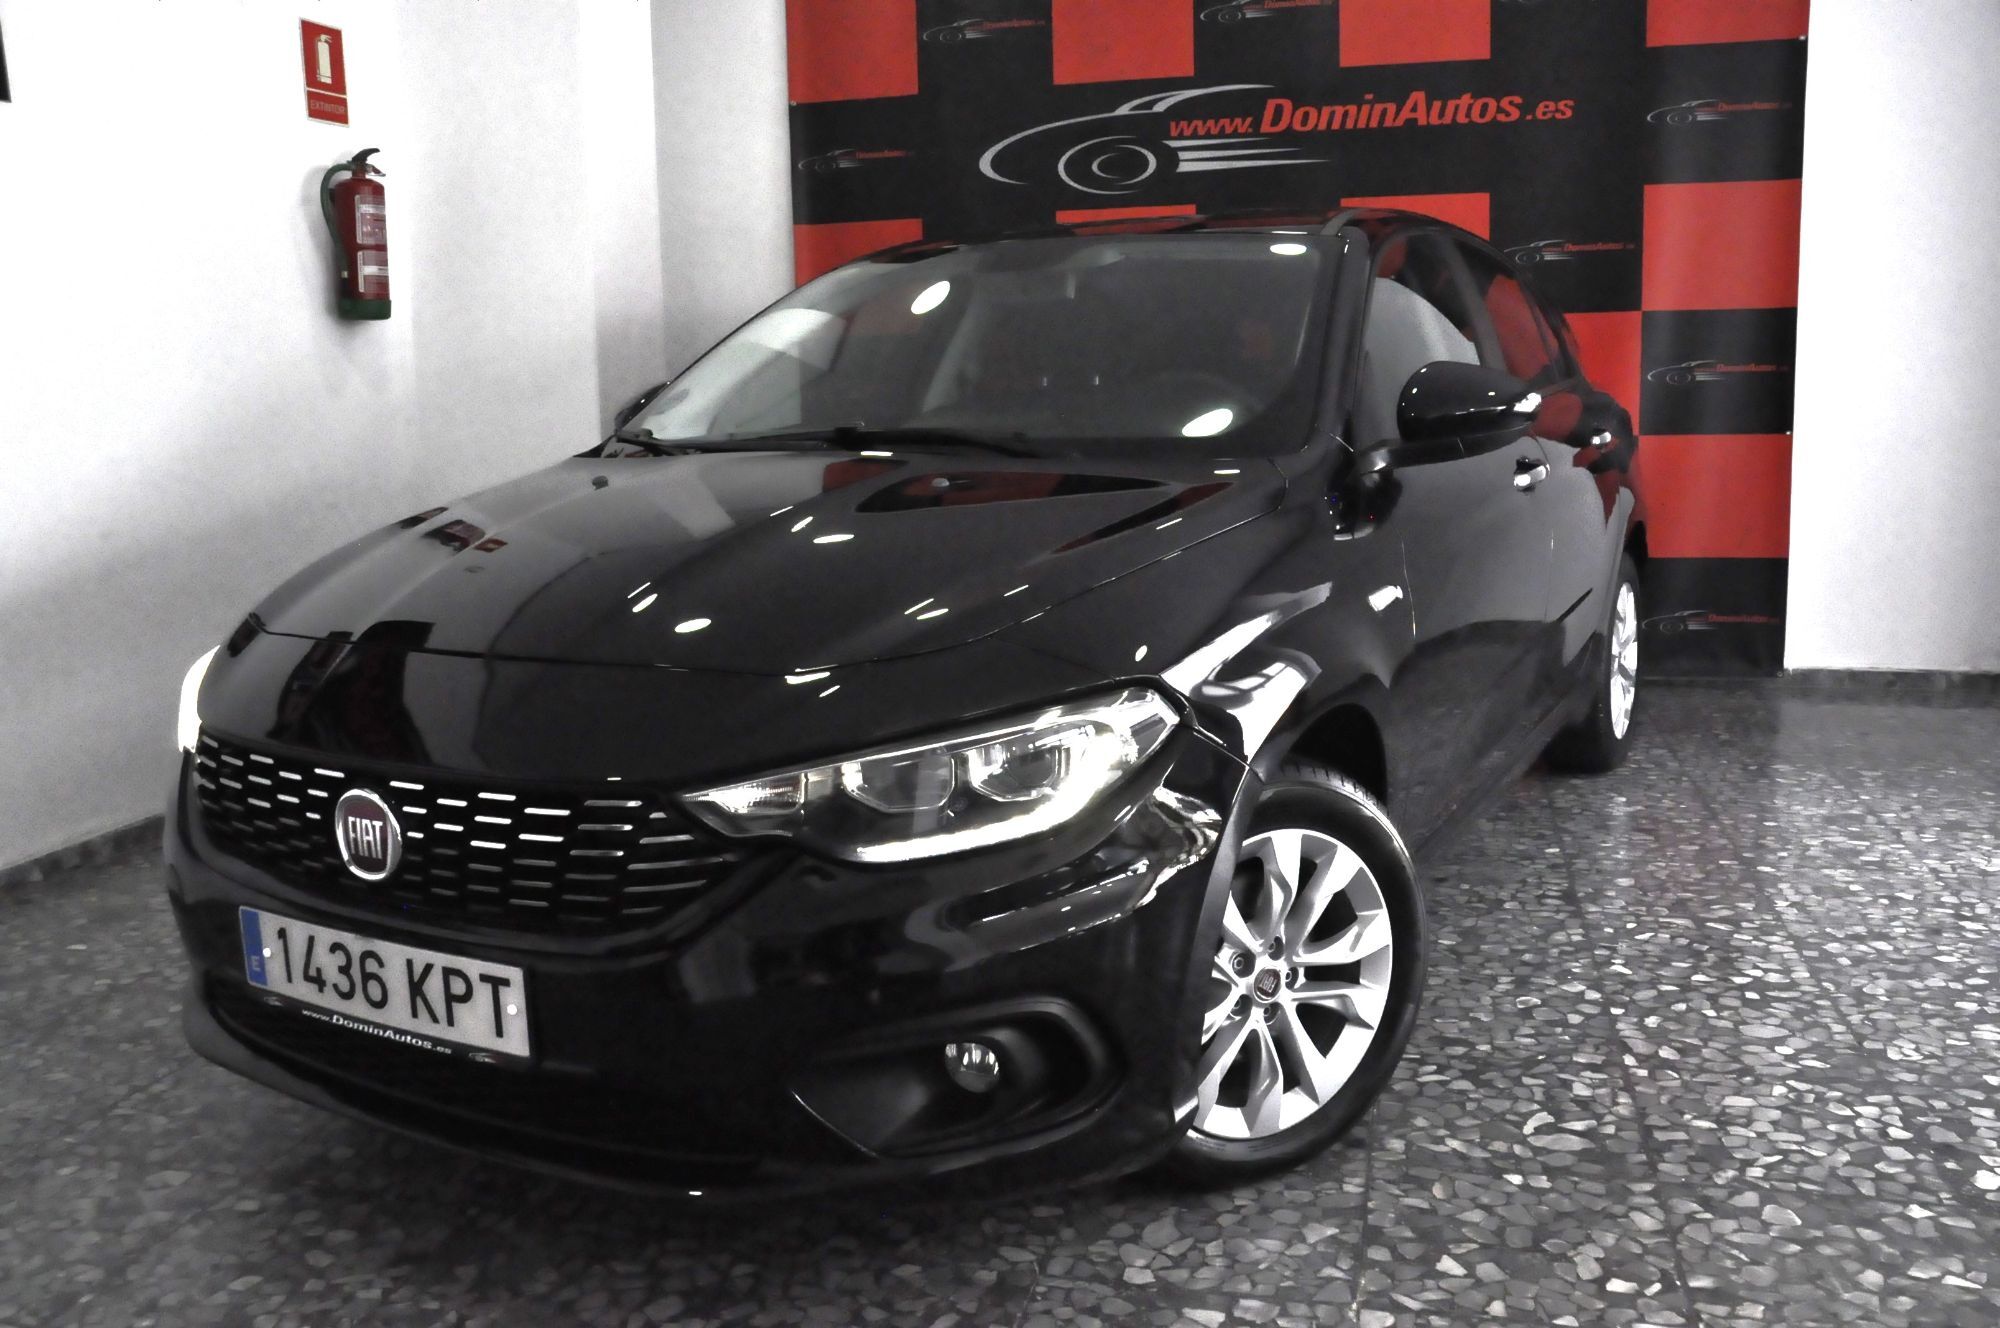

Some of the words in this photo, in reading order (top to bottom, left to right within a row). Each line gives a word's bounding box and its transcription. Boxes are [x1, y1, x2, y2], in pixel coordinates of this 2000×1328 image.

[348, 816, 383, 859] FIAT
[251, 955, 262, 972] E
[277, 927, 388, 1009] 1436
[406, 958, 510, 1038] KPT
[301, 1008, 453, 1055] www.DominAutos.es
